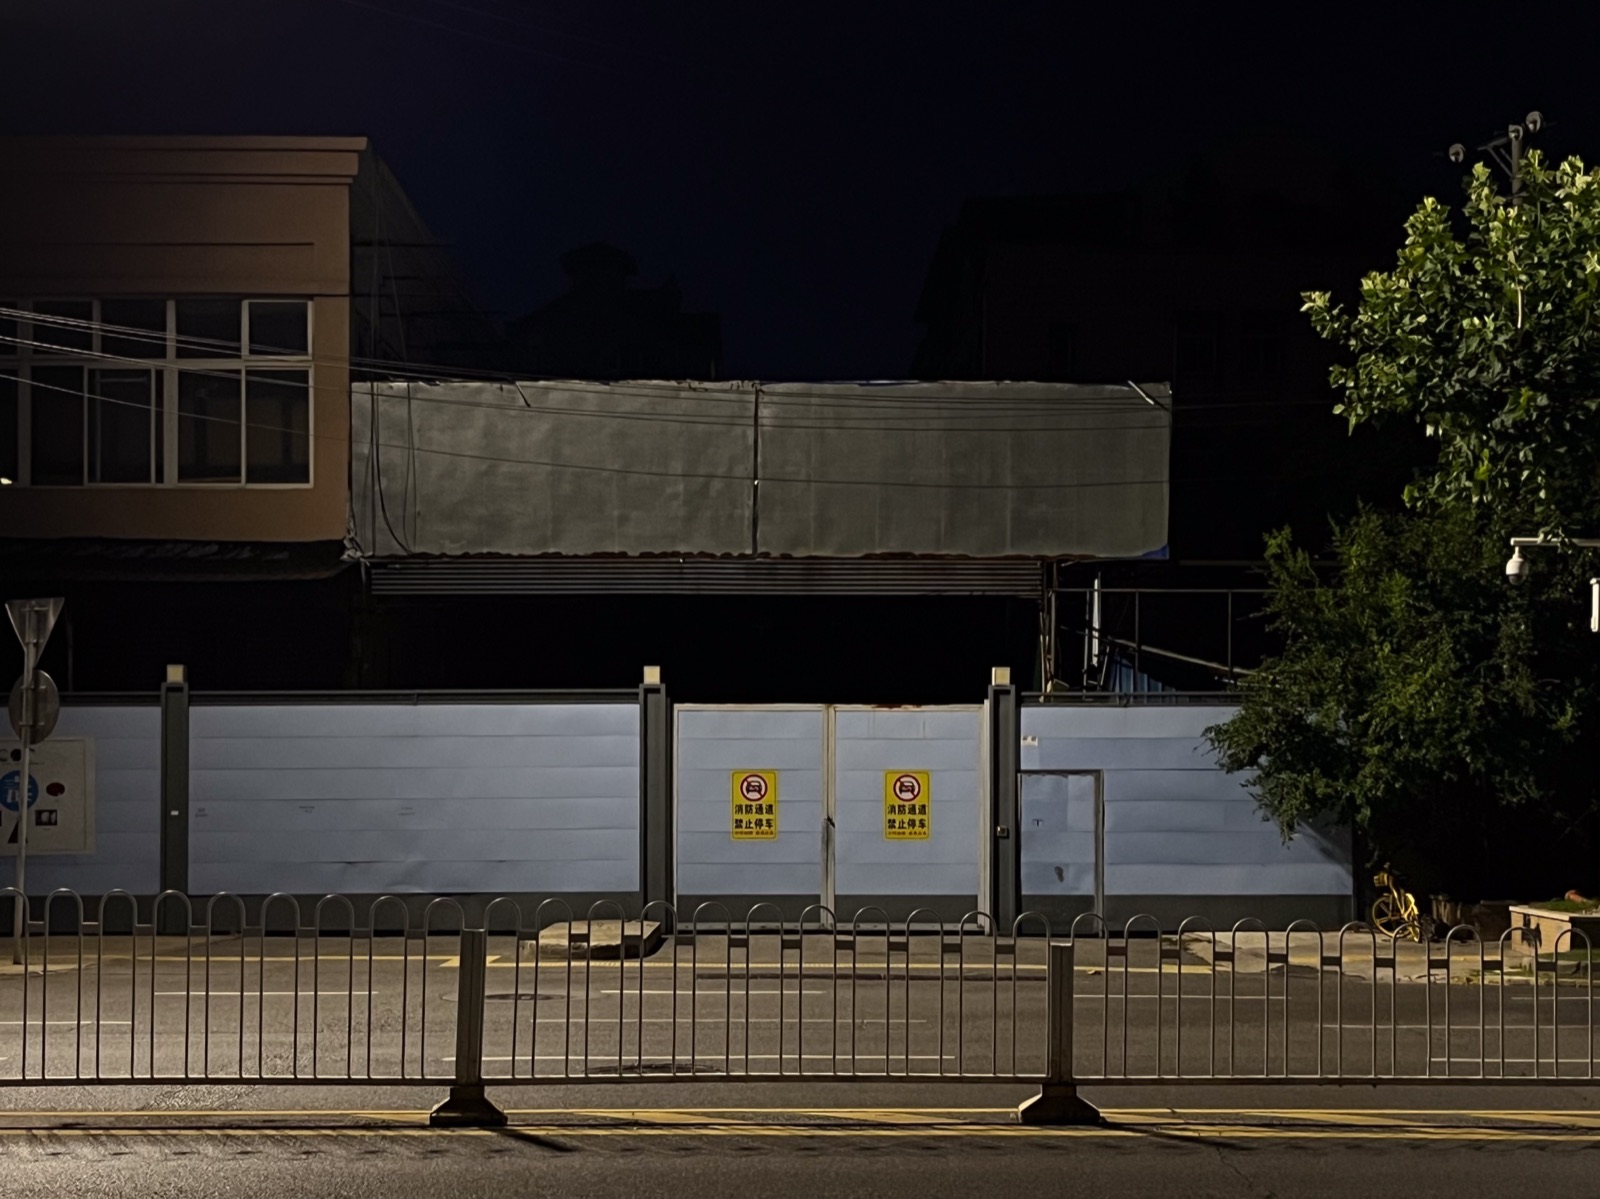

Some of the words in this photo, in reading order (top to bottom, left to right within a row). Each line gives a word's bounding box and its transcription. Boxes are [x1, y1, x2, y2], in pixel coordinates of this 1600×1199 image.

[735, 804, 774, 815] 消防通道
[888, 804, 927, 815] 消防通道
[735, 818, 774, 829] 禁止停车
[888, 818, 927, 829] 禁止停车
